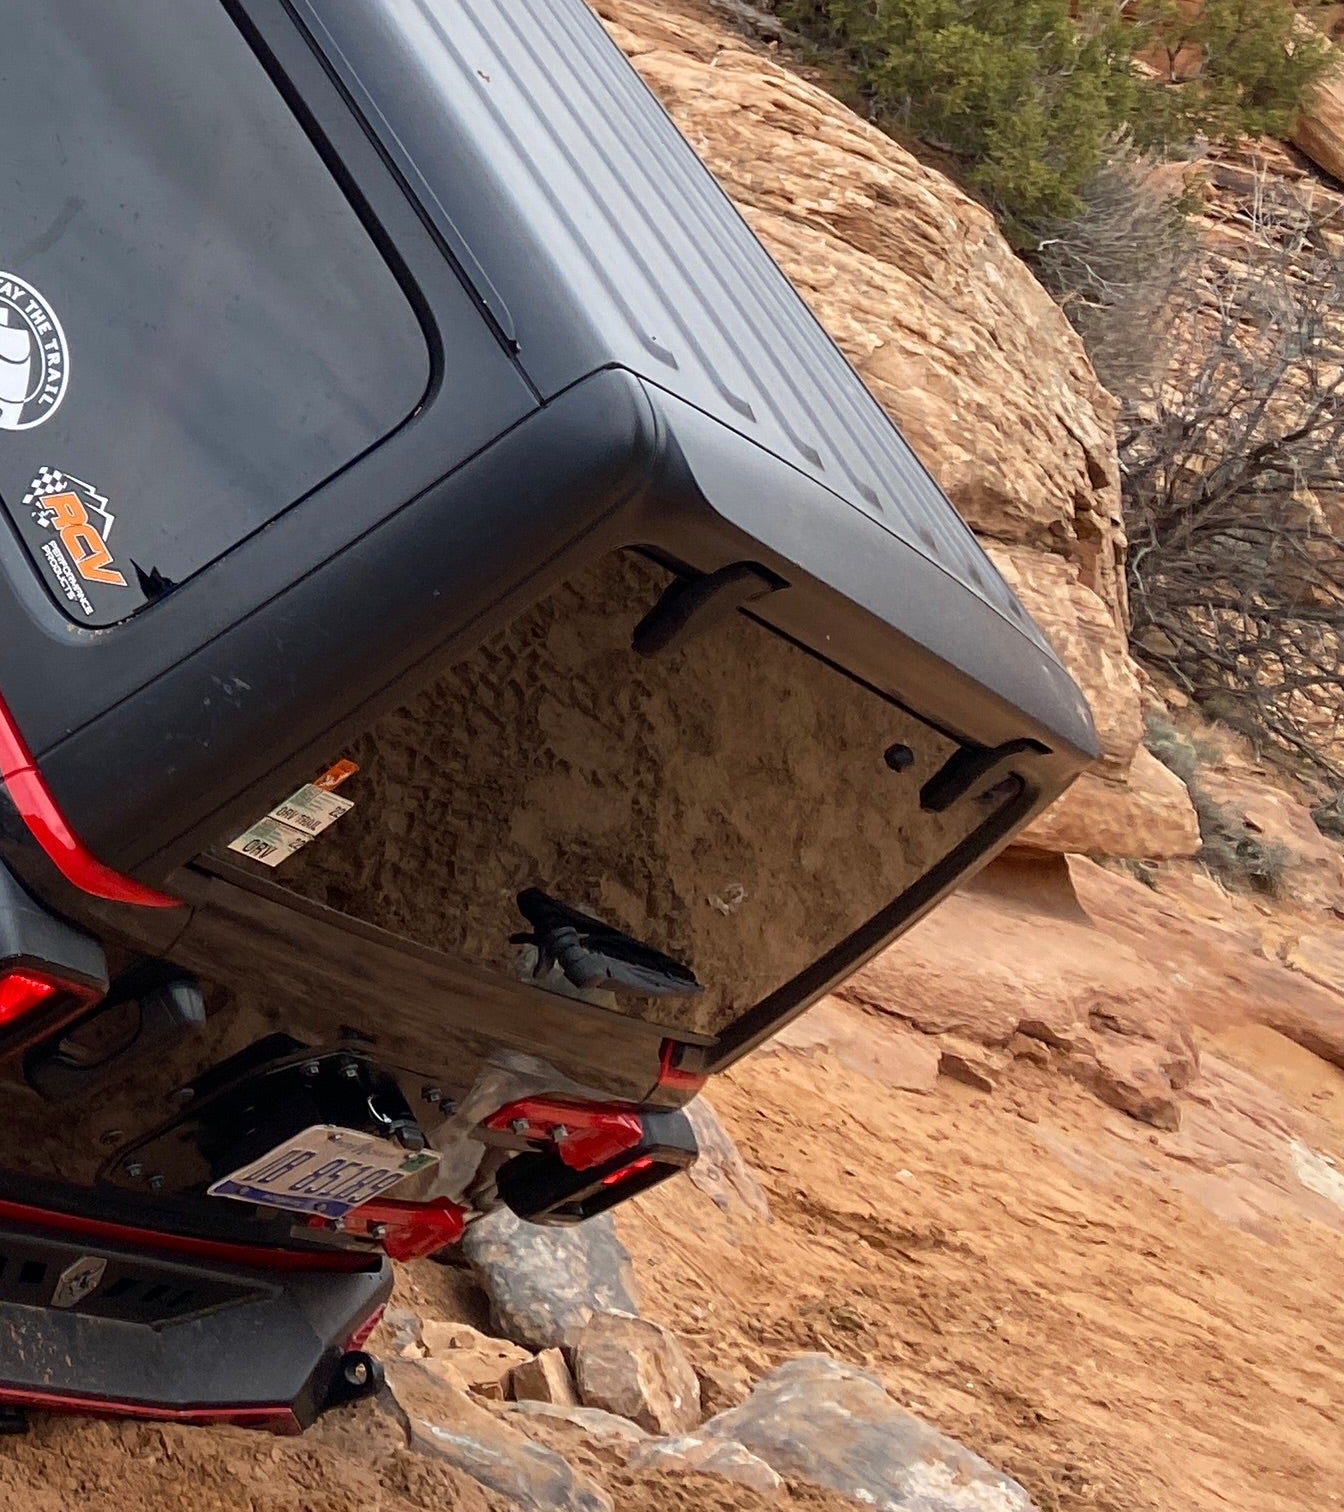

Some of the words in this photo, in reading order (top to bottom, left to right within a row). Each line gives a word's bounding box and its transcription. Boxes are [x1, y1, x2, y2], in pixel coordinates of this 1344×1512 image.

[24, 299, 53, 336] THE
[37, 337, 62, 406] TRAIL
[39, 491, 128, 586] RCV
[41, 544, 76, 601] PRODUCTS
[47, 539, 95, 616] PERFORMANCE
[275, 806, 298, 821] ORV
[296, 814, 322, 831] TRAIL
[242, 839, 278, 859] ORV
[288, 1159, 404, 1202] 85189
